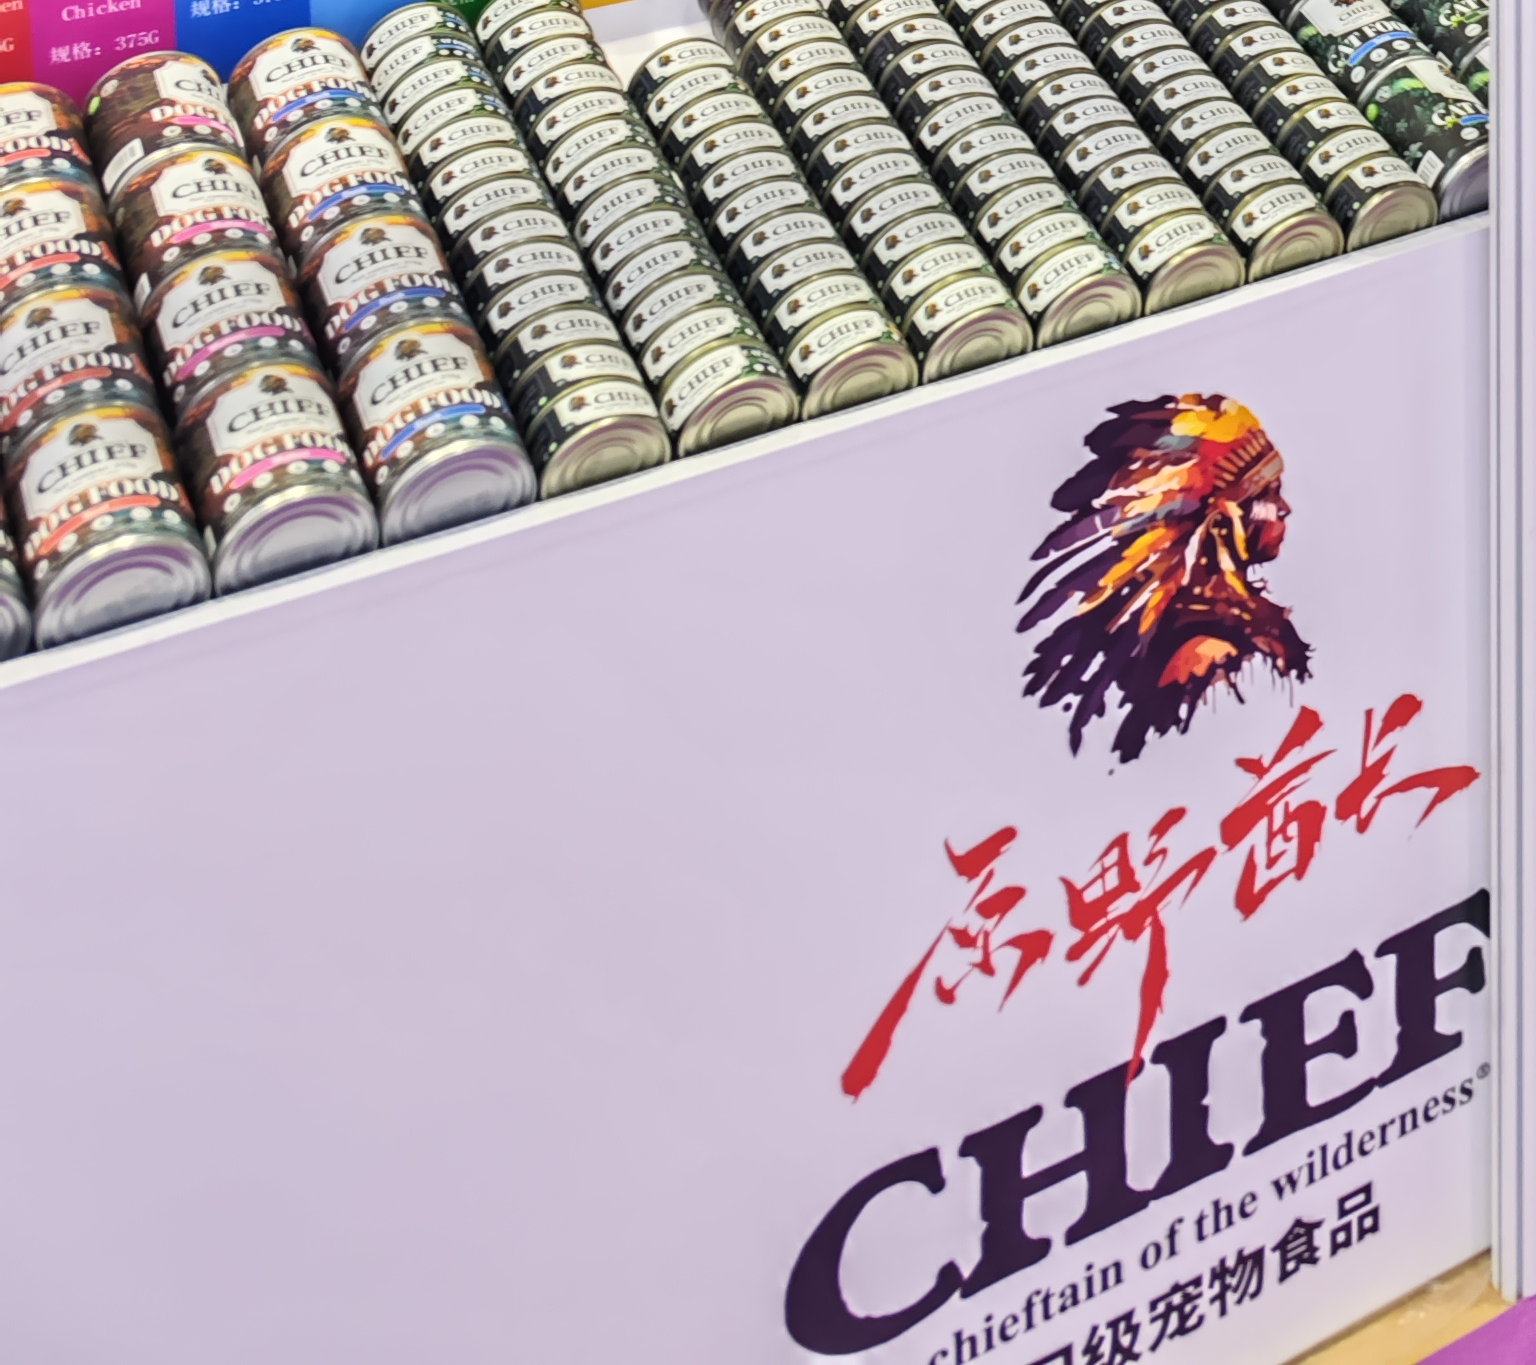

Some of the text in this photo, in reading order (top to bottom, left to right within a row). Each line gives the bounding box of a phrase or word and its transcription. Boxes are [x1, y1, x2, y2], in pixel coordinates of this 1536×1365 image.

[115, 30, 160, 52] 375G
[840, 692, 1482, 1104] 原野酋长
[784, 886, 1492, 1357] CHIEF
[1139, 1215, 1184, 1270] of
[1193, 1185, 1259, 1243] the
